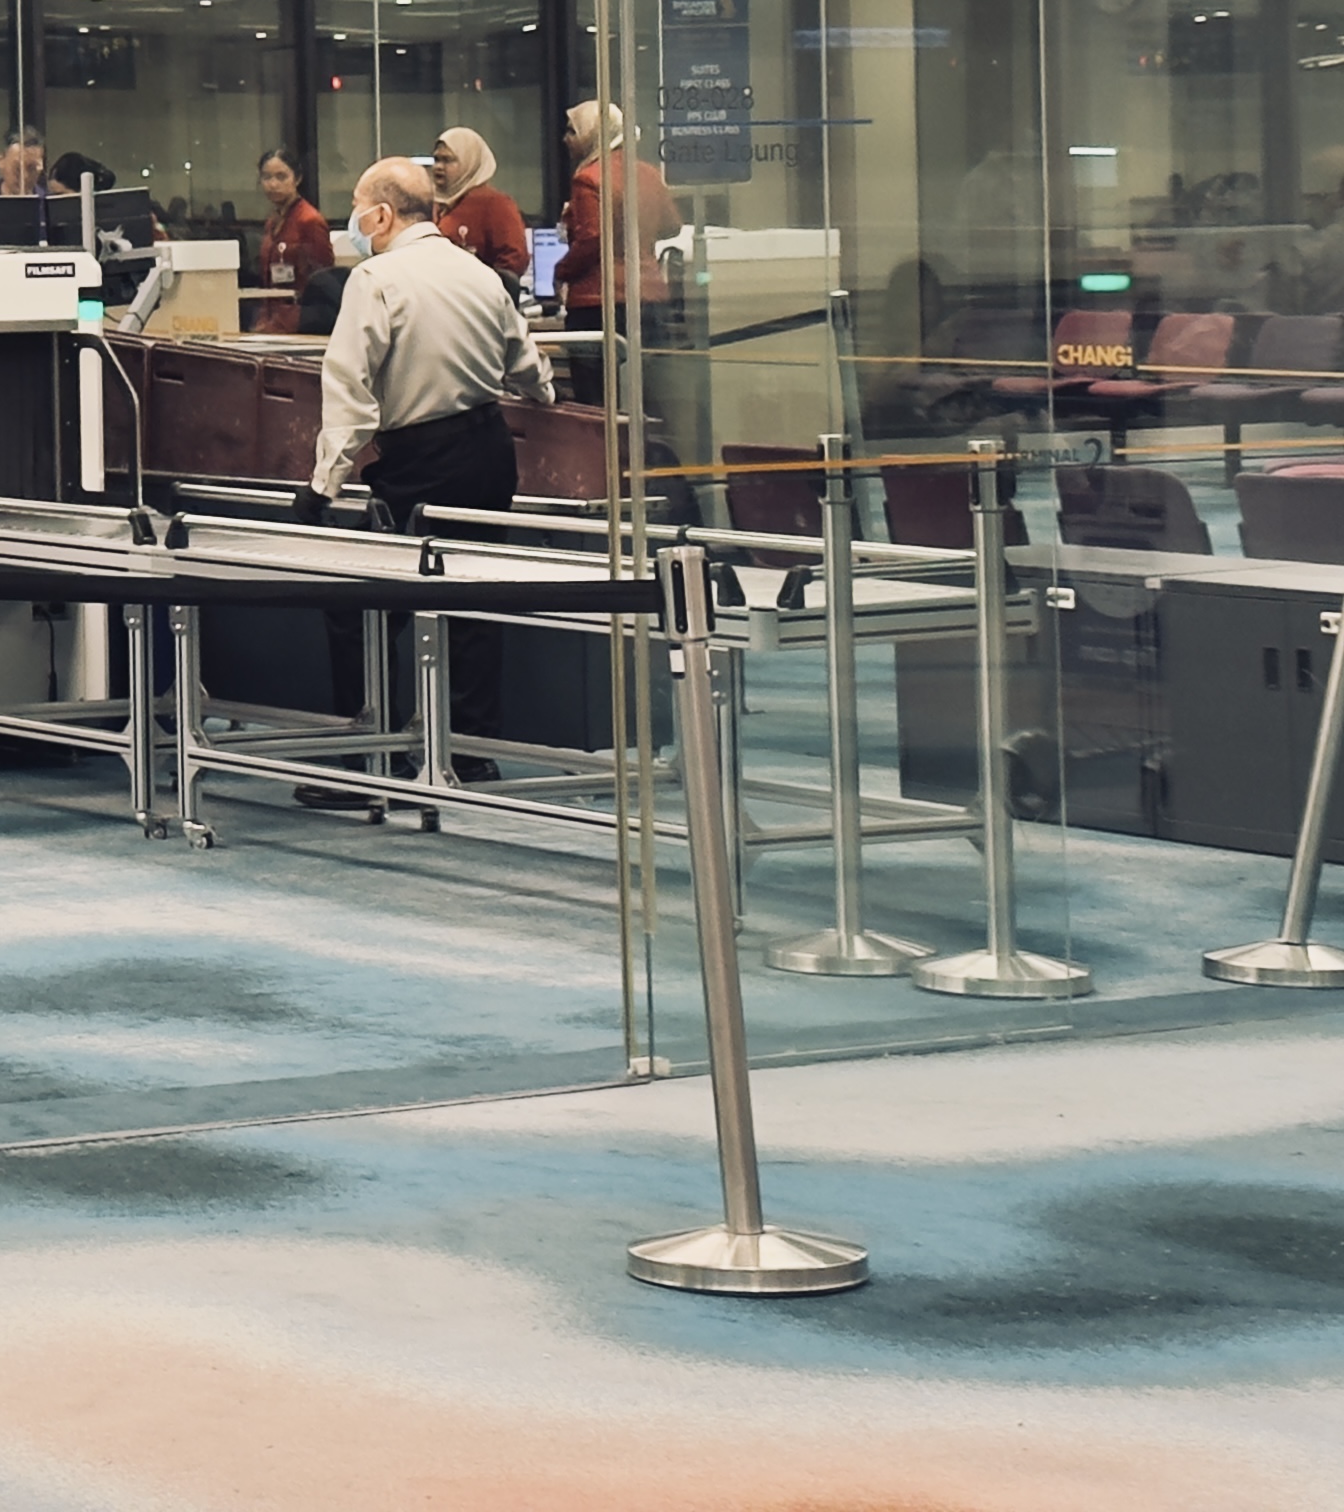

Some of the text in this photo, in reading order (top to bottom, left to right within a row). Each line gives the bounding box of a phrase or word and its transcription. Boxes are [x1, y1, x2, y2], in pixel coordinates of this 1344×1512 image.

[658, 139, 800, 168] Gate Loung
[26, 265, 74, 276] FILMSAFE
